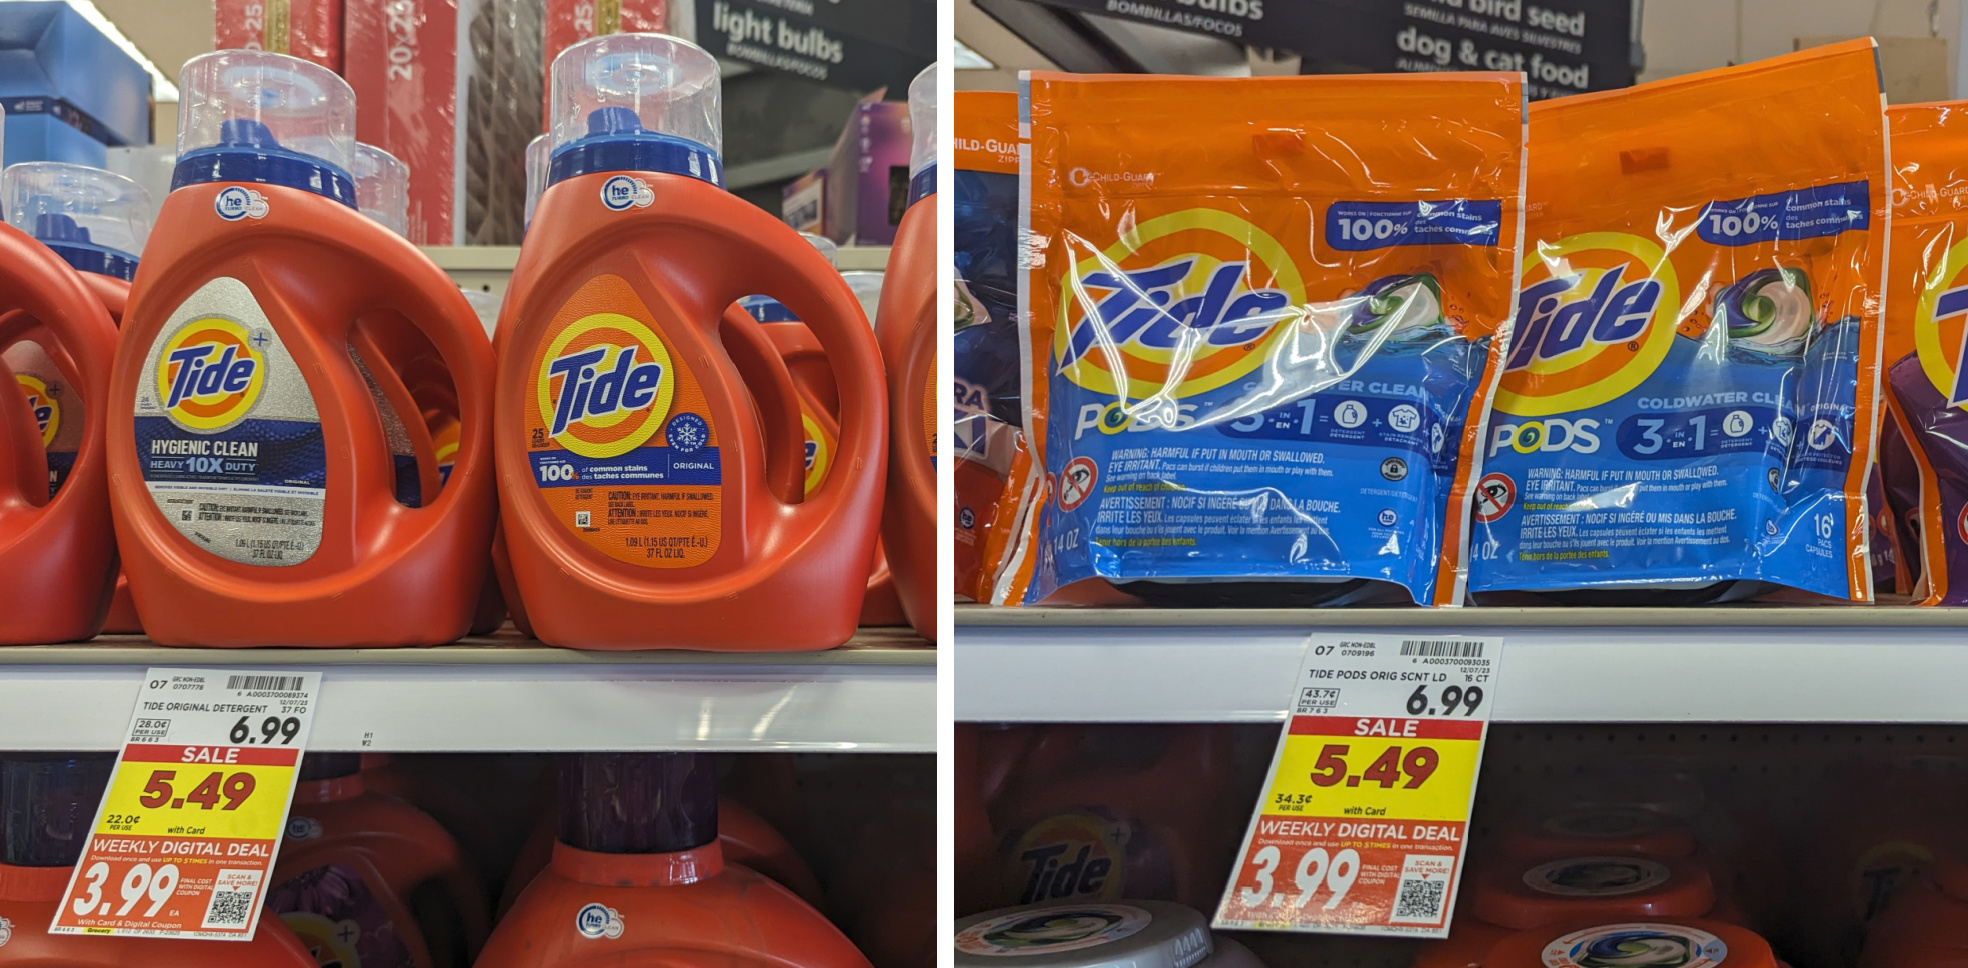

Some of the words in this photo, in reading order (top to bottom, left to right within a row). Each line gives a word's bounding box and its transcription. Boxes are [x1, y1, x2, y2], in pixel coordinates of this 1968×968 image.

[1106, 1, 1243, 37] BOMBILLAS/FOCOS
[1527, 5, 1585, 37] seed
[713, 1, 773, 45] light
[778, 18, 844, 63] bulbs
[1404, 3, 1456, 25] SEMILLA
[1457, 15, 1489, 34] PARA
[1489, 23, 1520, 41] AVES
[1521, 31, 1582, 55] SILVESTRES
[1397, 26, 1451, 65] dog
[1459, 39, 1478, 67] &
[1484, 49, 1524, 71] cat
[1530, 53, 1589, 89] food
[1786, 200, 1823, 211] common
[1338, 218, 1408, 241] 100%
[1709, 212, 1779, 237] 100%
[1055, 256, 1292, 376] Tide
[166, 343, 256, 411] Tide
[547, 345, 663, 438] Tide
[1637, 392, 1748, 410] COLDWATER
[1297, 398, 1316, 435] 1
[532, 428, 544, 438] 25
[1489, 418, 1600, 458] PODS
[1633, 418, 1664, 455] 3
[1688, 414, 1706, 451] 1
[152, 440, 210, 455] HYGIENIC
[214, 441, 258, 457] CLEAN
[1672, 440, 1686, 448] EN
[150, 460, 183, 469] HEAVY
[186, 457, 224, 473] 10X
[225, 462, 256, 472] DUTY
[539, 464, 580, 482] 100%
[673, 462, 714, 470] ORIGINAL
[1528, 468, 1564, 479] WARNING:
[1565, 469, 1599, 480] HARMFUL
[1601, 470, 1608, 481] IF
[1609, 470, 1624, 481] PUT
[1625, 470, 1633, 481] IN
[1634, 470, 1660, 481] MOUTH
[1662, 469, 1672, 480] OR
[1673, 465, 1719, 480] SWALLOWED.
[594, 472, 619, 480] taches
[1521, 514, 1581, 526] AVERTISSEMENT
[1585, 512, 1607, 524] NOCIF
[1609, 512, 1616, 524] SI
[1617, 510, 1644, 524] INGÉRÉ
[1646, 512, 1656, 523] OU
[1658, 512, 1672, 523] MIS
[1673, 512, 1694, 524] DANS
[1696, 511, 1706, 524] LA
[1707, 508, 1737, 523] BOUCHE.
[1813, 514, 1833, 540] 16
[625, 538, 638, 547] 1.09
[659, 538, 667, 547] US
[668, 538, 690, 547] QT/PTE
[1066, 529, 1080, 550] OZ
[1817, 540, 1832, 549] PACS
[646, 549, 654, 558] 37
[655, 549, 663, 558] FL
[664, 549, 672, 558] OZ
[1482, 542, 1498, 560] OZ
[1805, 544, 1834, 558] CAPSULES
[1315, 646, 1335, 655] 07
[150, 680, 168, 689] 07
[1309, 669, 1334, 679] TIDE
[1337, 670, 1367, 680] PODS
[1370, 671, 1397, 680] ORIG
[1400, 672, 1428, 681] SCNT
[1432, 673, 1447, 682] LD
[1476, 674, 1489, 683] CT
[1305, 690, 1336, 698] 43.7¢
[1406, 684, 1483, 716] 6.99
[143, 702, 164, 711] TIDE
[166, 703, 210, 712] ORIGINAL
[213, 704, 268, 714] DETERGENT
[281, 706, 291, 714] 37
[294, 706, 307, 714] FO
[138, 720, 167, 729] 28.0¢
[229, 716, 300, 745] 6.99
[1354, 718, 1419, 737] SALE
[181, 747, 241, 764] SALE
[1311, 744, 1439, 790] 5.49
[139, 770, 256, 810] 5.49
[1275, 794, 1313, 804] 34.3¢
[106, 814, 141, 824] 22.0¢
[1343, 807, 1363, 815] with
[1365, 807, 1386, 816] Card
[167, 826, 185, 834] with
[187, 826, 205, 835] Card
[1260, 820, 1336, 836] WEEKLY
[1338, 823, 1407, 839] DIGITAL
[1413, 826, 1460, 841] DEAL
[93, 839, 159, 854] WEEKLY
[161, 841, 223, 855] DIGITAL
[227, 844, 269, 857] DEAL
[1240, 845, 1361, 910] 3.99
[1426, 867, 1450, 875] MORE!
[72, 861, 180, 918] 3.99
[77, 918, 95, 926] With
[97, 919, 116, 927] Card
[124, 920, 150, 929] Digital
[152, 921, 182, 929] Coupon
